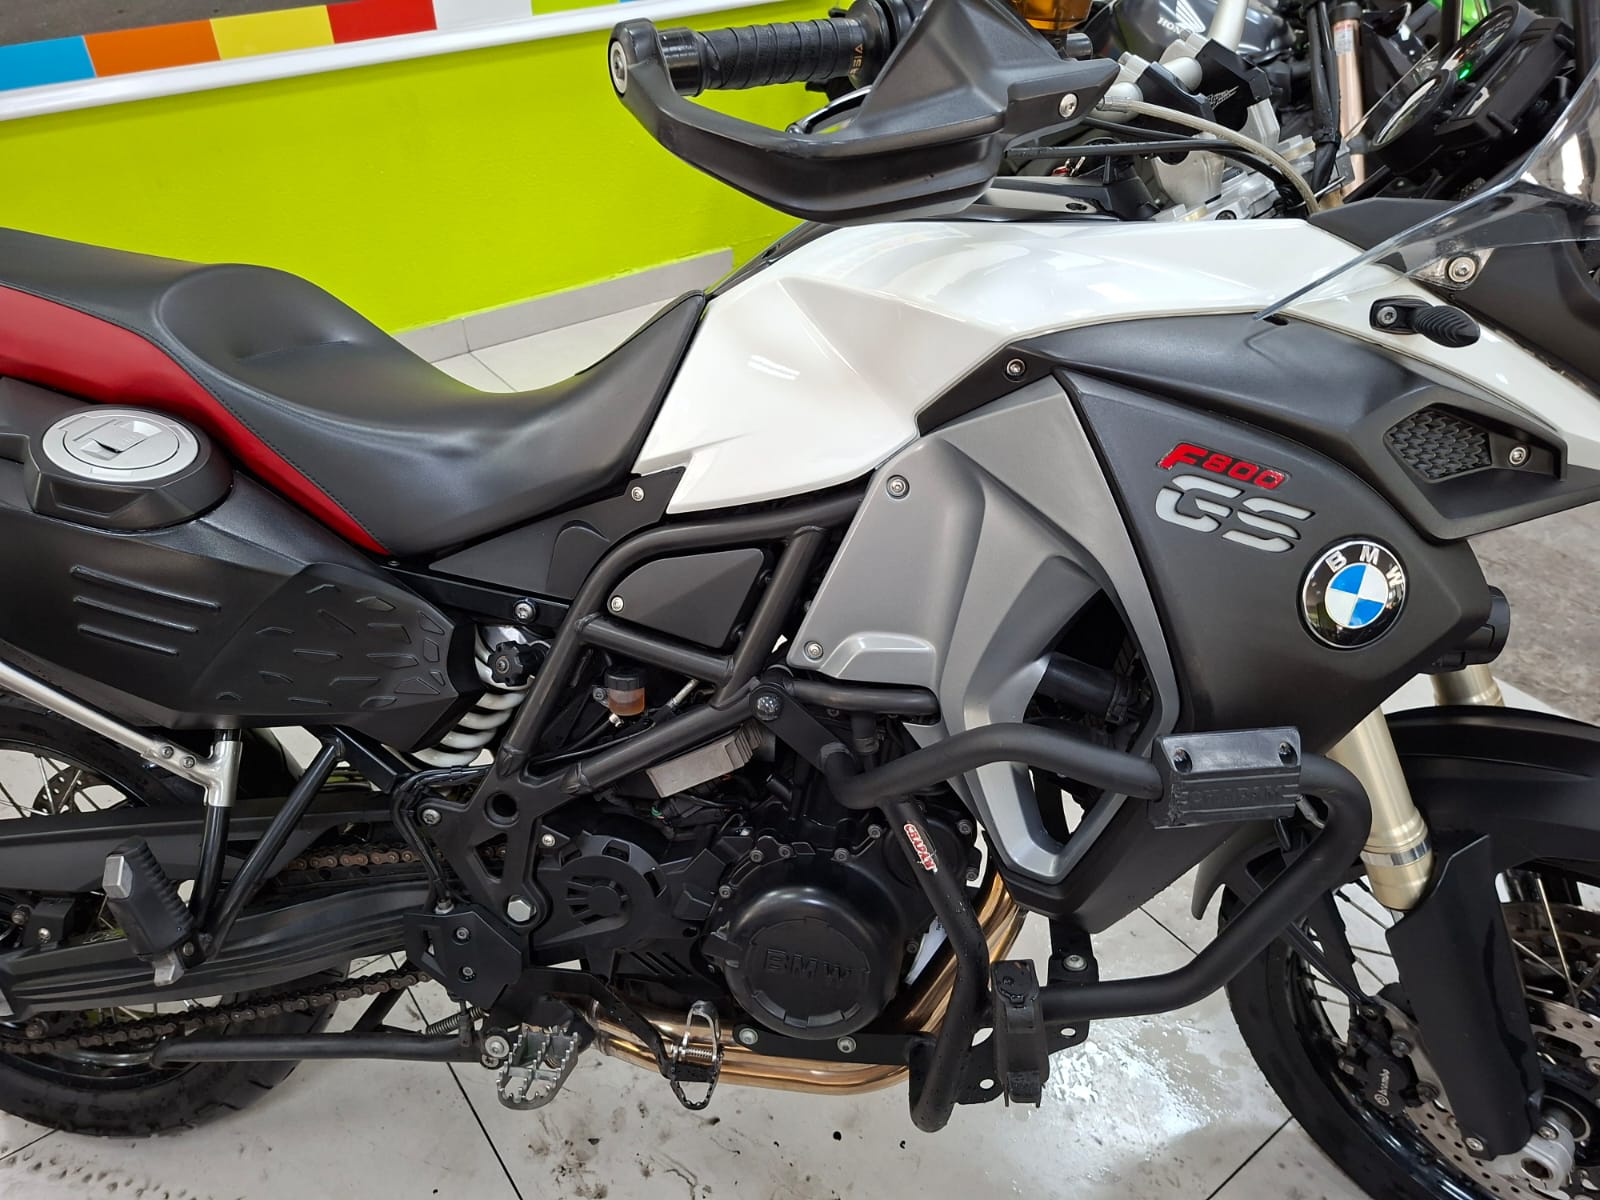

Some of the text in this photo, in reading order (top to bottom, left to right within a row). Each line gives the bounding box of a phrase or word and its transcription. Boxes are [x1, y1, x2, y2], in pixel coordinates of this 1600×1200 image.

[1157, 16, 1182, 35] HON
[1158, 443, 1285, 490] F800
[1155, 475, 1315, 552] GS
[1325, 545, 1404, 587] BMW
[764, 948, 853, 982] BMW
